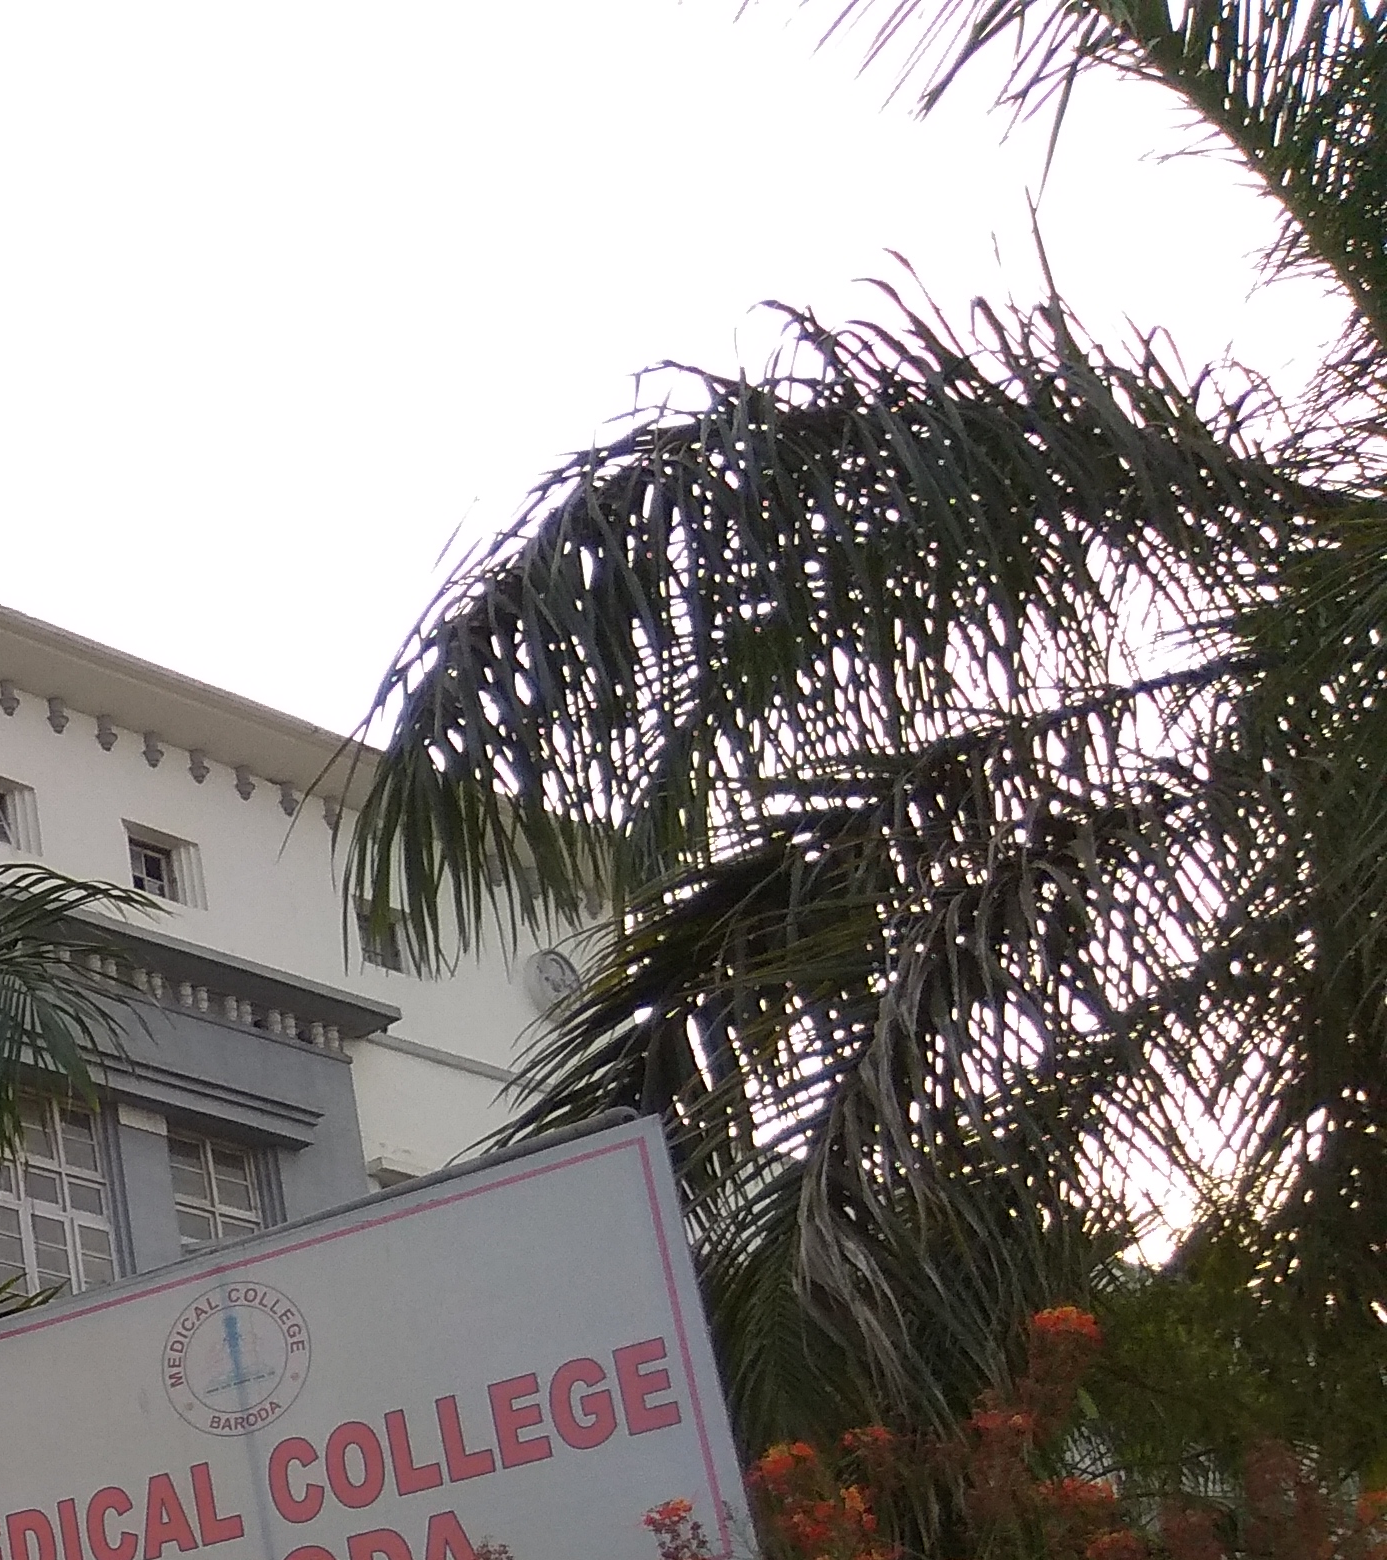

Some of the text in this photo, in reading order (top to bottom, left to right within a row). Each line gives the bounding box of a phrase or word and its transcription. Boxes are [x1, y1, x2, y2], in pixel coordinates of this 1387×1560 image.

[167, 1287, 306, 1389] MEDICAL COLLEGE
[208, 1400, 283, 1431] BARODA
[268, 1337, 682, 1524] COLLEGE
